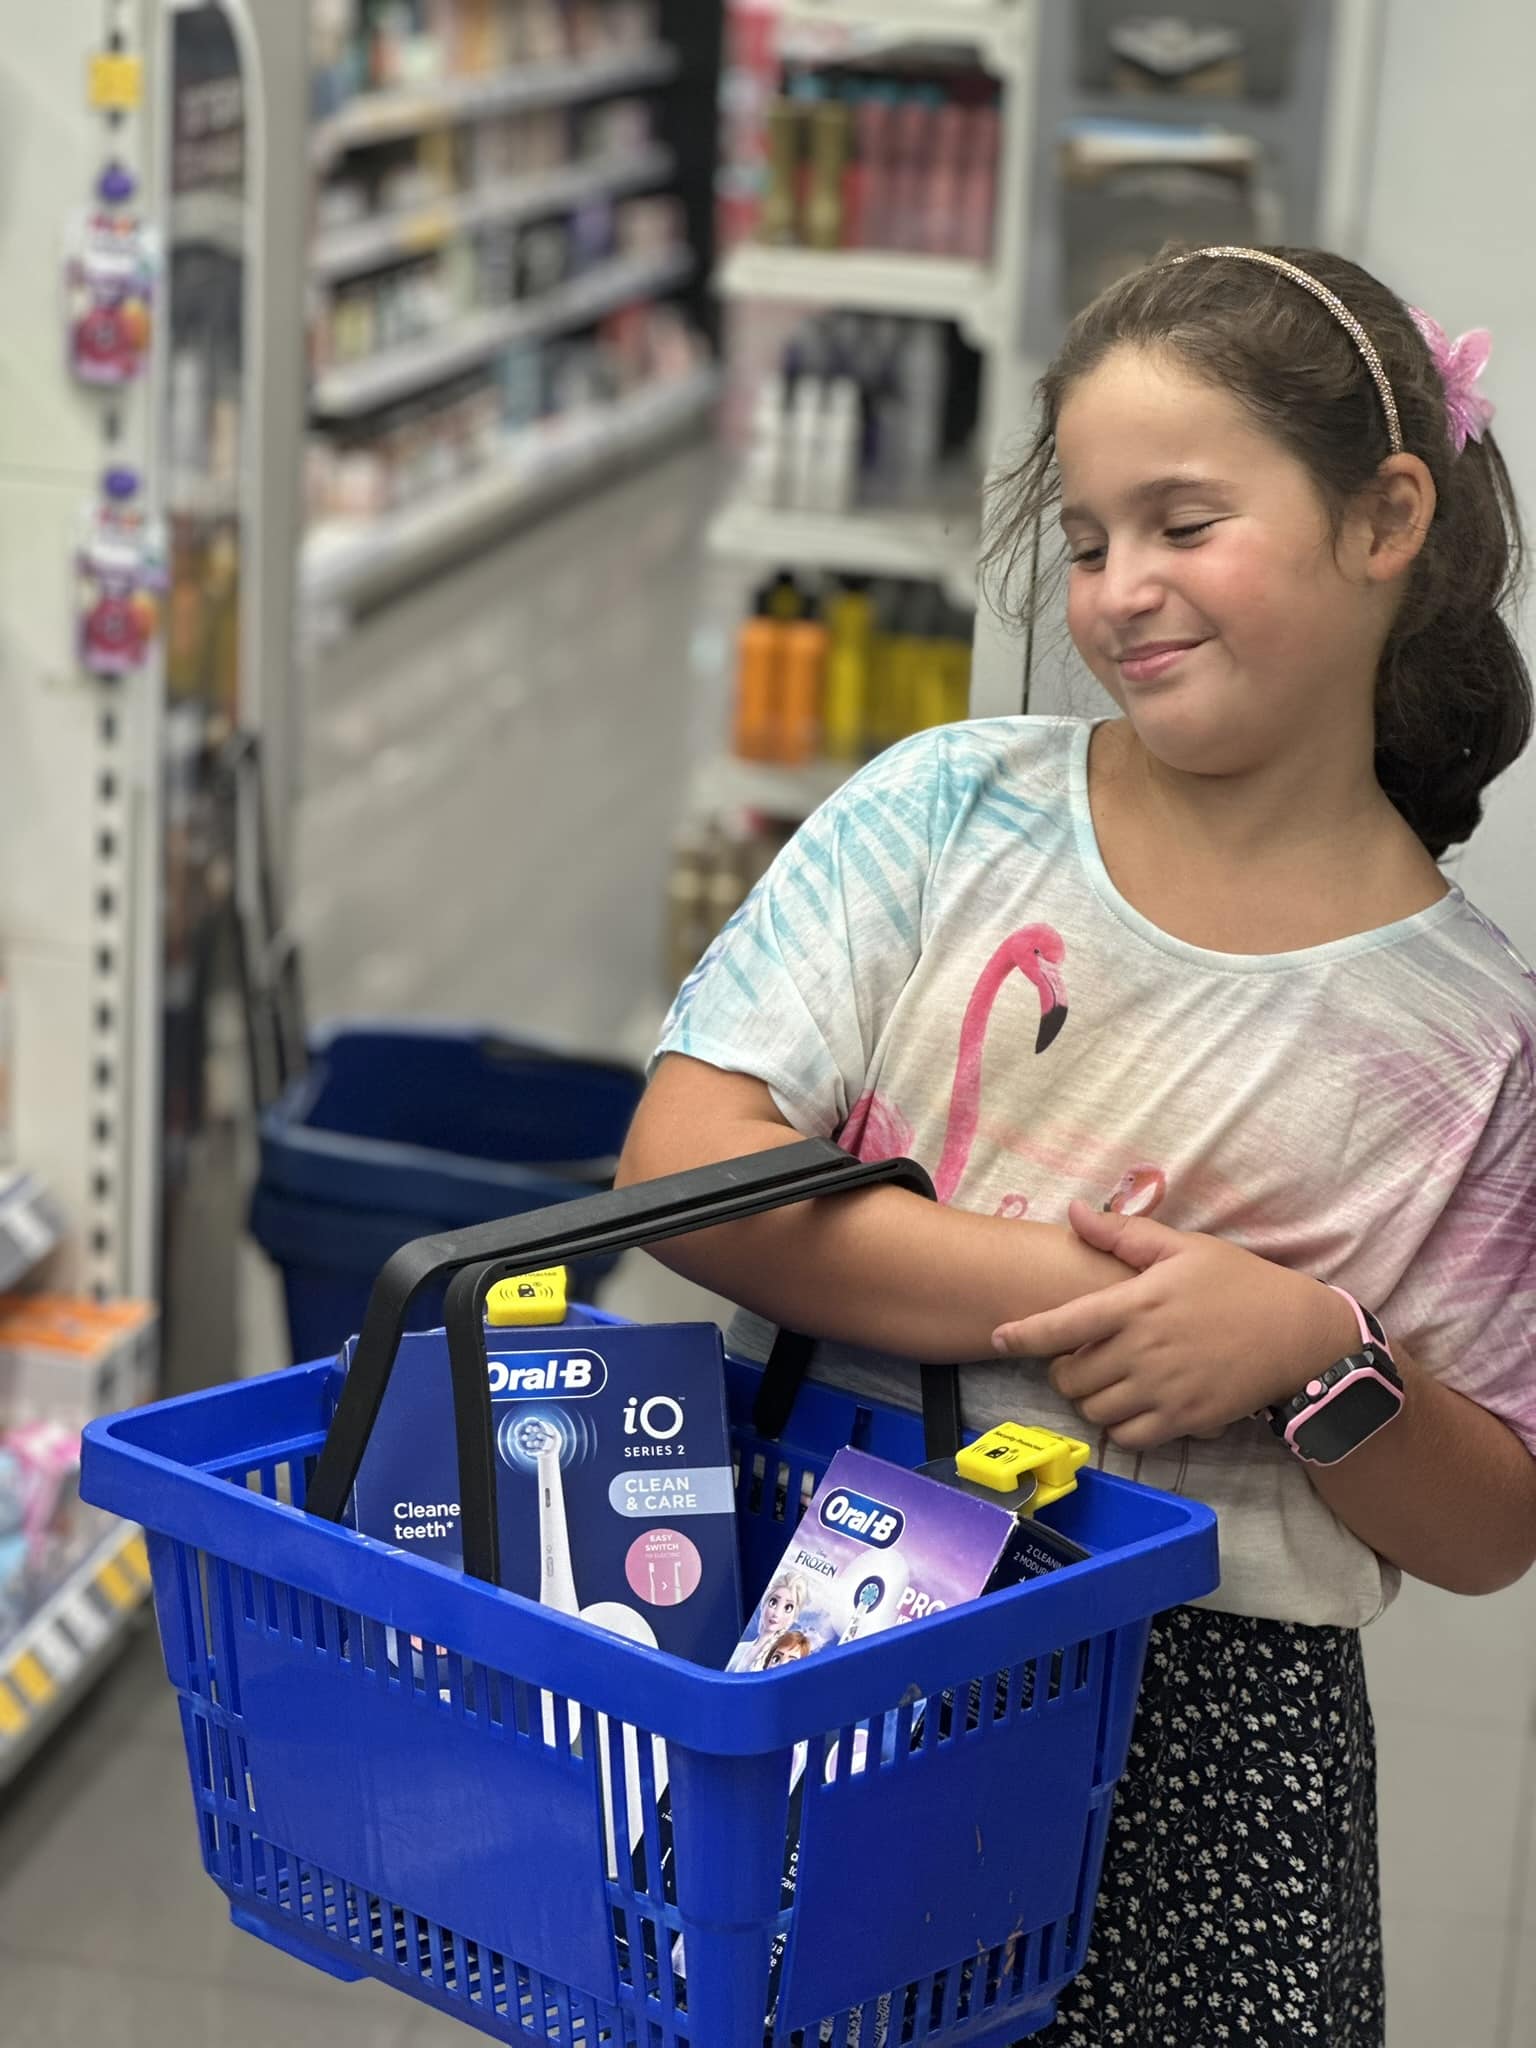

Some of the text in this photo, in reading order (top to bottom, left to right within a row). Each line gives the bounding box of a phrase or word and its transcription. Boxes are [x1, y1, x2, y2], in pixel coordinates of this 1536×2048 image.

[488, 1359, 592, 1392] Oral-B
[624, 1444, 686, 1457] SERIES 2
[624, 1476, 690, 1494] CLEAN
[393, 1501, 461, 1519] Cleane
[626, 1493, 697, 1511] & CARE
[825, 1495, 898, 1542] Oral-B
[649, 1534, 673, 1543] EASY
[644, 1543, 680, 1553] SWITCH
[1025, 1544, 1034, 1554] 2
[794, 1549, 838, 1578] FROZEN
